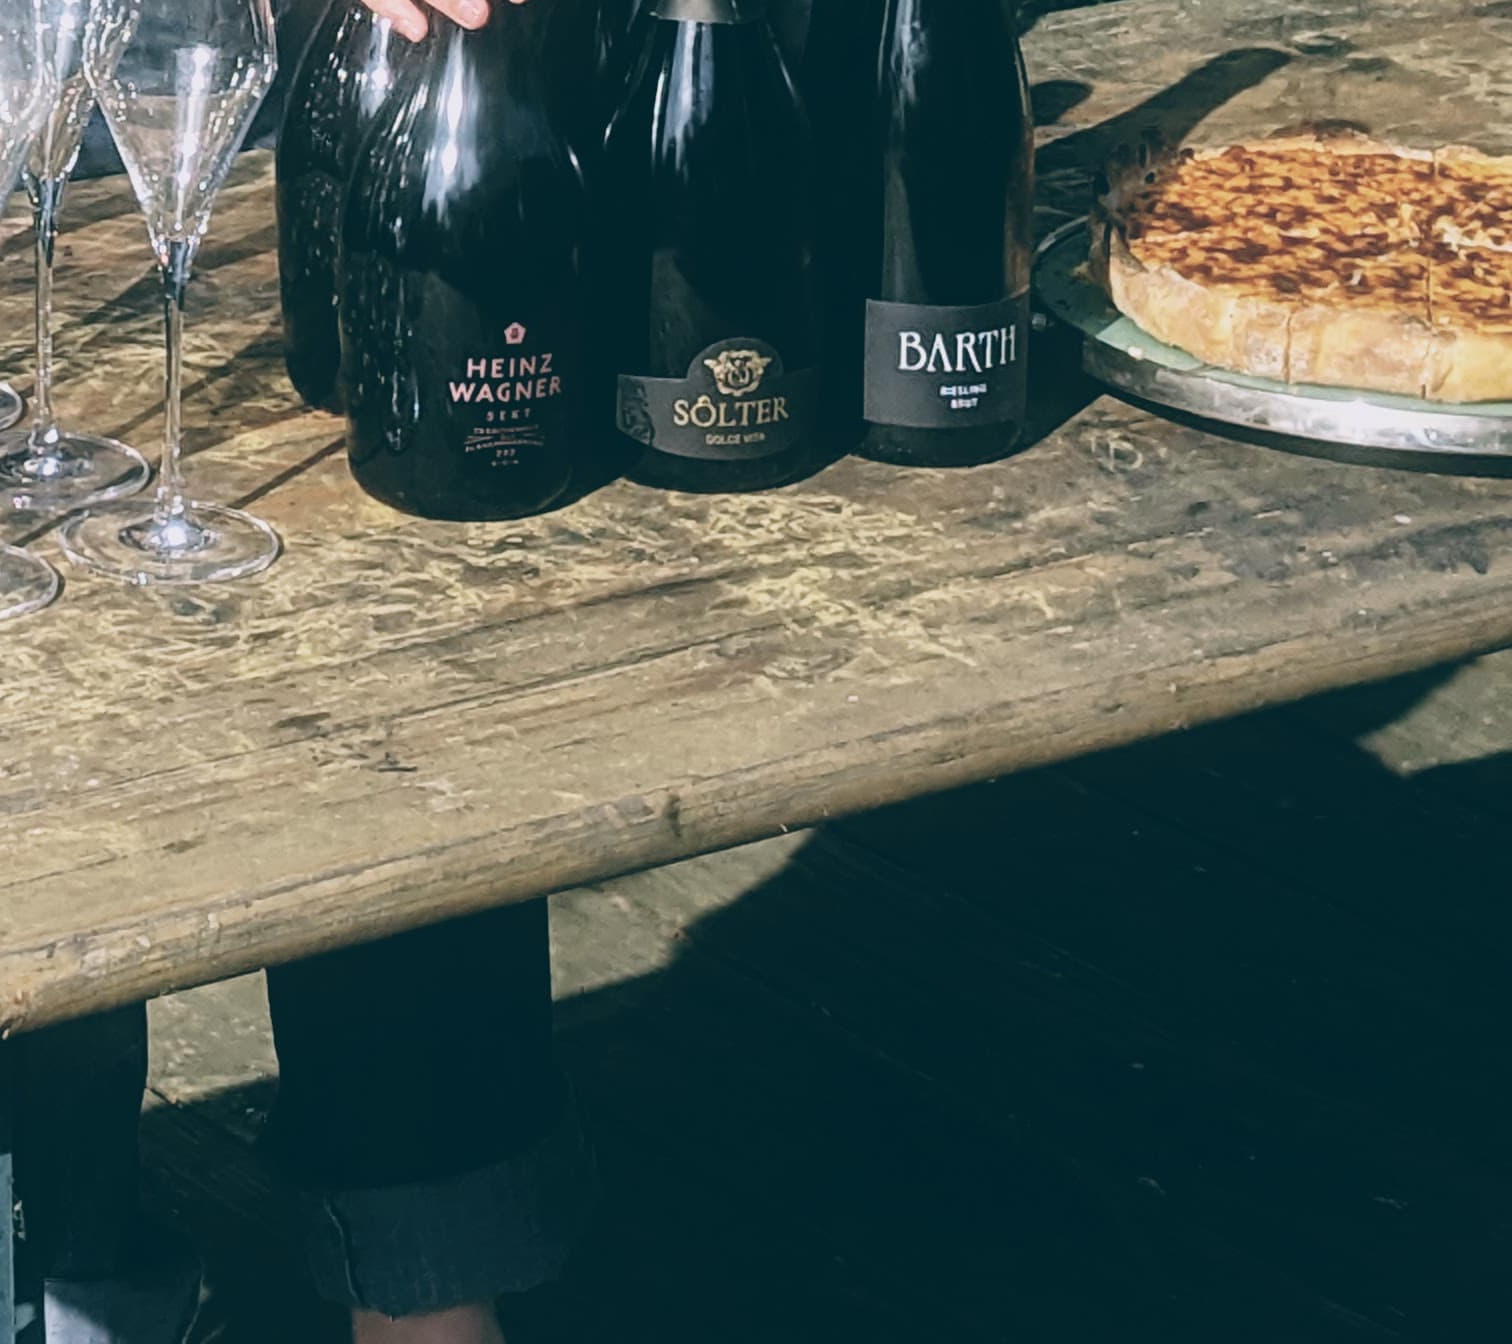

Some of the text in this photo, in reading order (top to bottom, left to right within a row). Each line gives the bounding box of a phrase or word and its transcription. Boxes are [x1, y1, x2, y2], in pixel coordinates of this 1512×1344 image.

[898, 324, 1016, 373] BARTH
[466, 353, 553, 379] HEINZ
[448, 375, 562, 403] WAGNER
